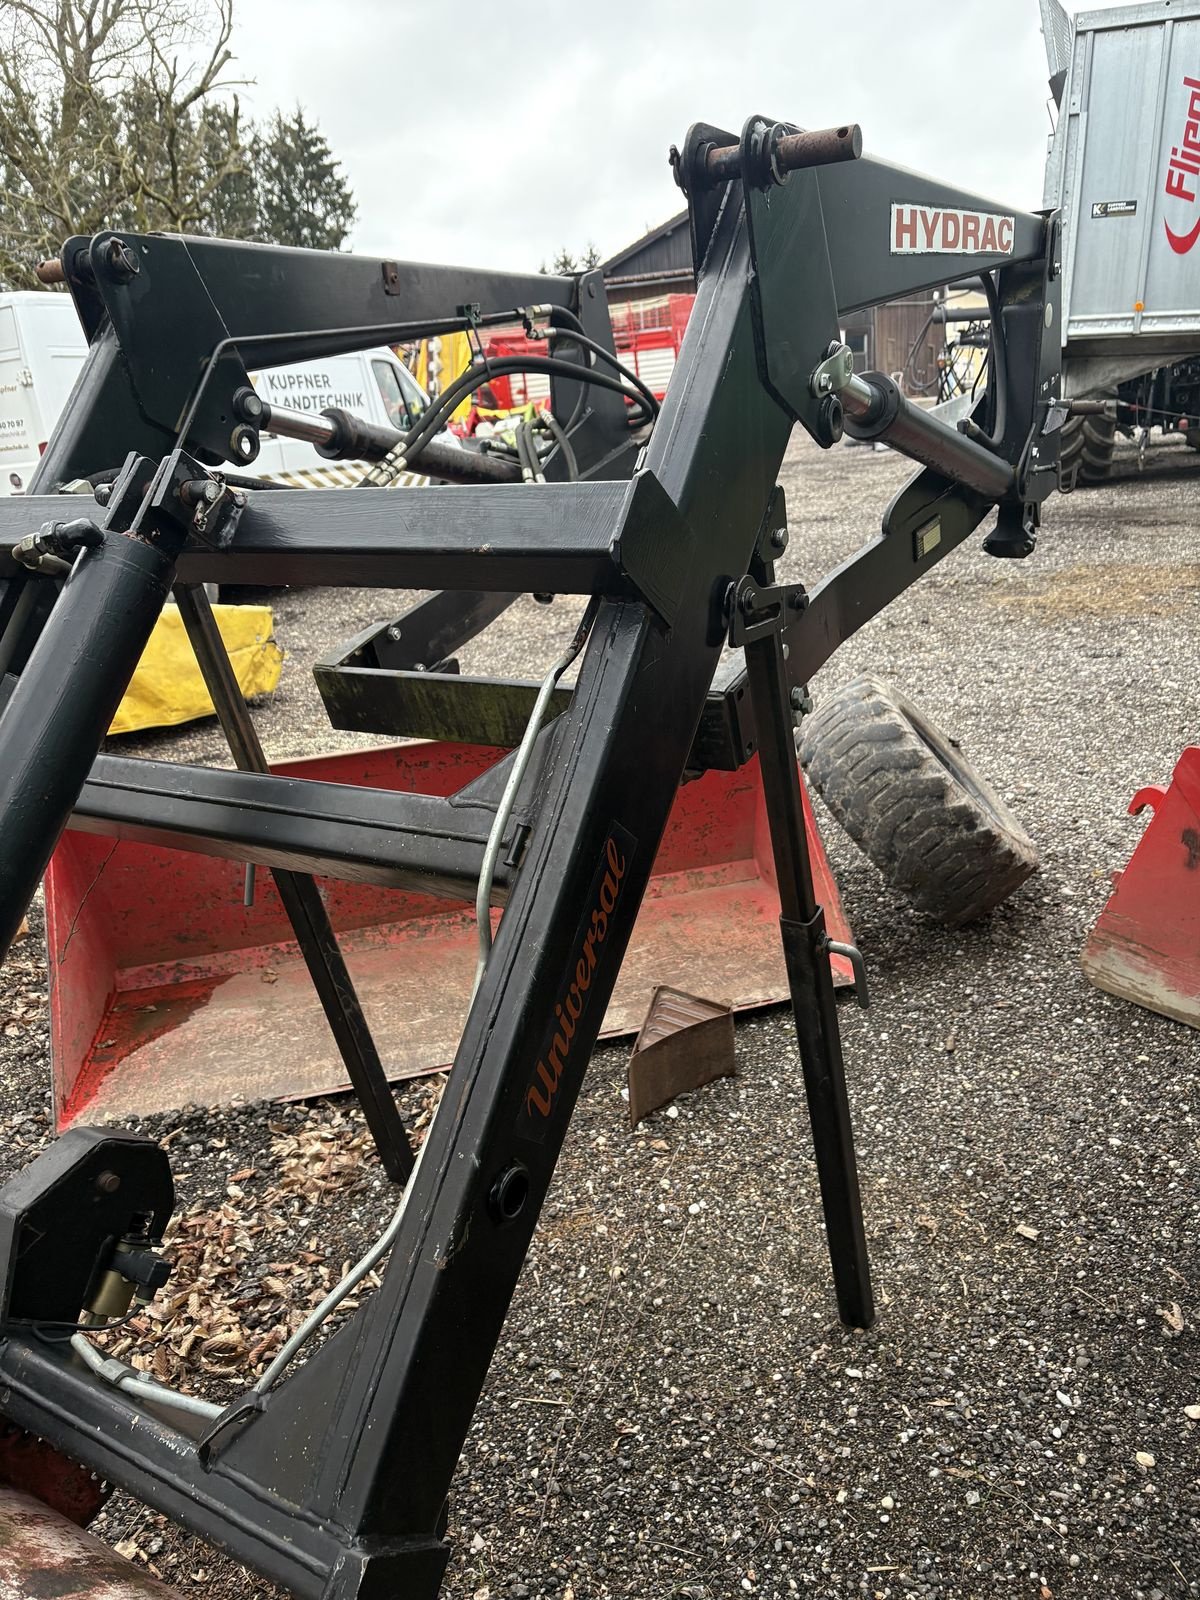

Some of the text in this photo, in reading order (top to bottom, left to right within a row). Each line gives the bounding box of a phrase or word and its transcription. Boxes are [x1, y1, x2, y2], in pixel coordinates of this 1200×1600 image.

[895, 208, 1013, 252] HYDRAC
[267, 374, 331, 390] KUPFNER
[527, 837, 625, 1118] Universal
